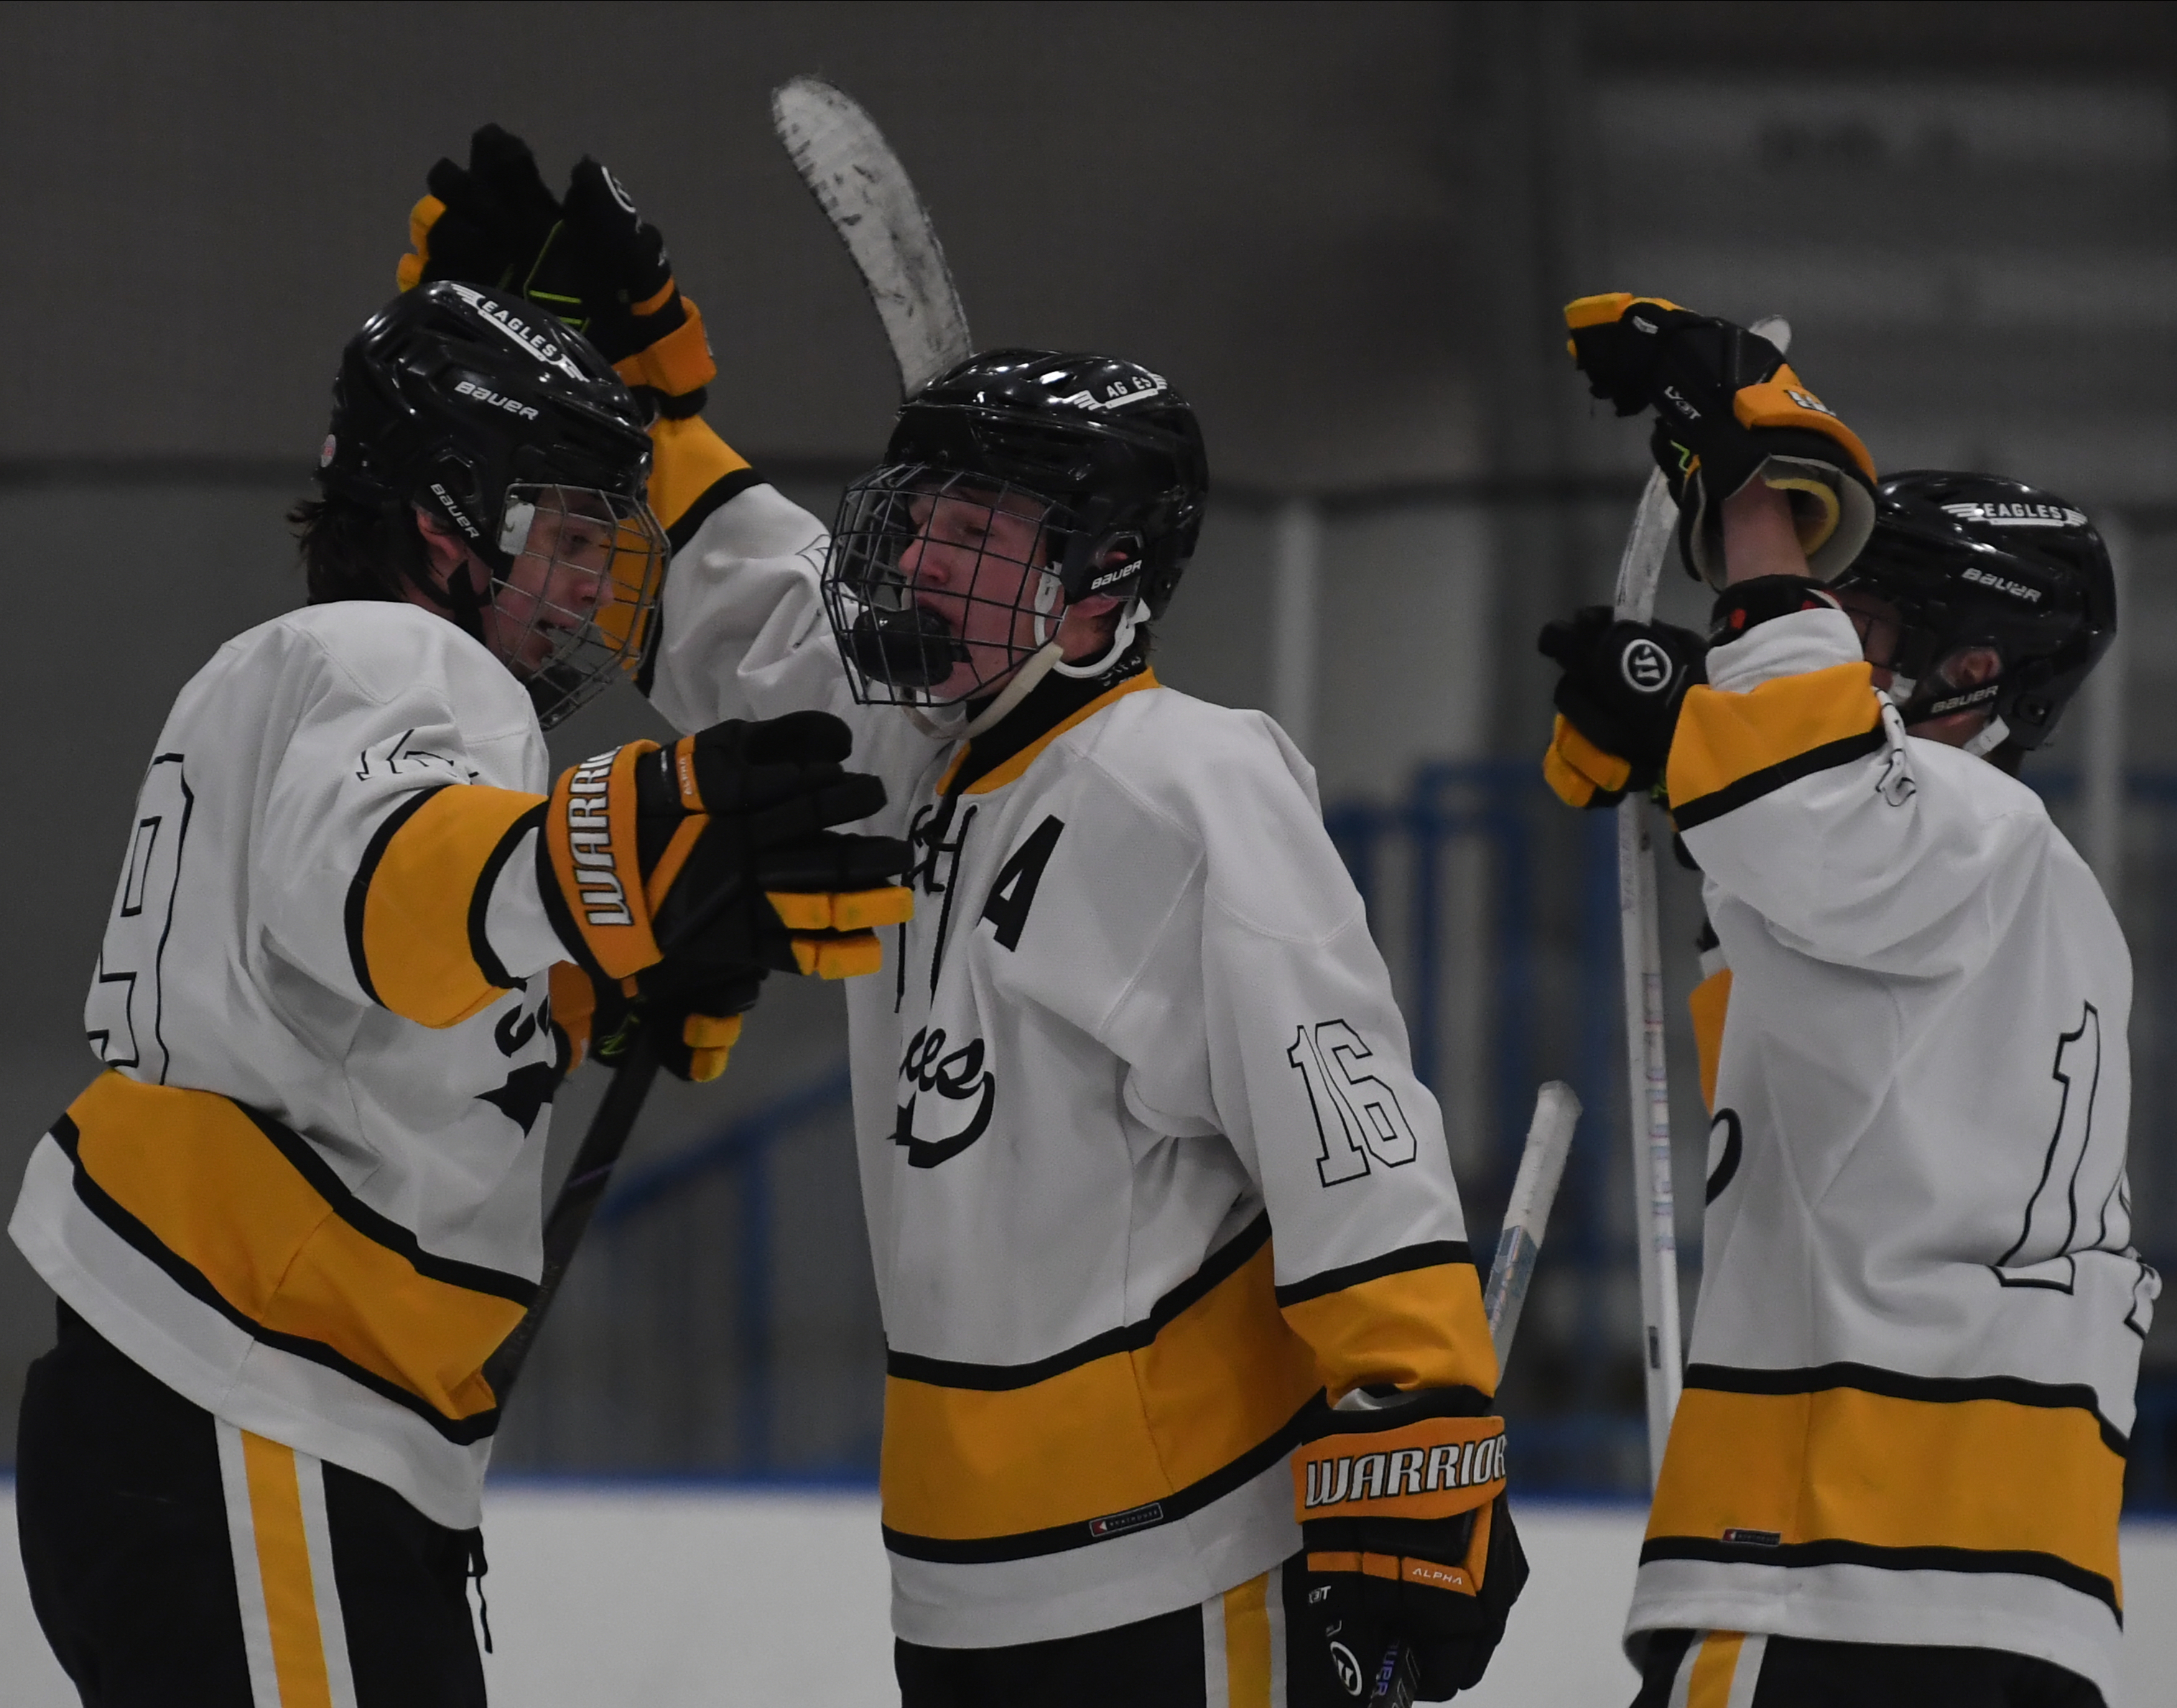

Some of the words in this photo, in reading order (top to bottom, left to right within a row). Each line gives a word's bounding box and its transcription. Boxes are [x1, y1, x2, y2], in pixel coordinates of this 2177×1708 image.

[483, 300, 558, 357] EAGLES
[454, 381, 539, 421] BAUER
[430, 482, 480, 539] BAUER
[1985, 503, 2062, 519] EAGLES
[1091, 559, 1143, 590] BAUER
[1961, 566, 2043, 603] BAUER
[1931, 684, 2000, 714] BAUER
[977, 814, 1065, 952] A
[1286, 1018, 1417, 1188] 16
[1304, 1433, 1507, 1509] WARRIOR
[1412, 1567, 1463, 1585] ALPHA
